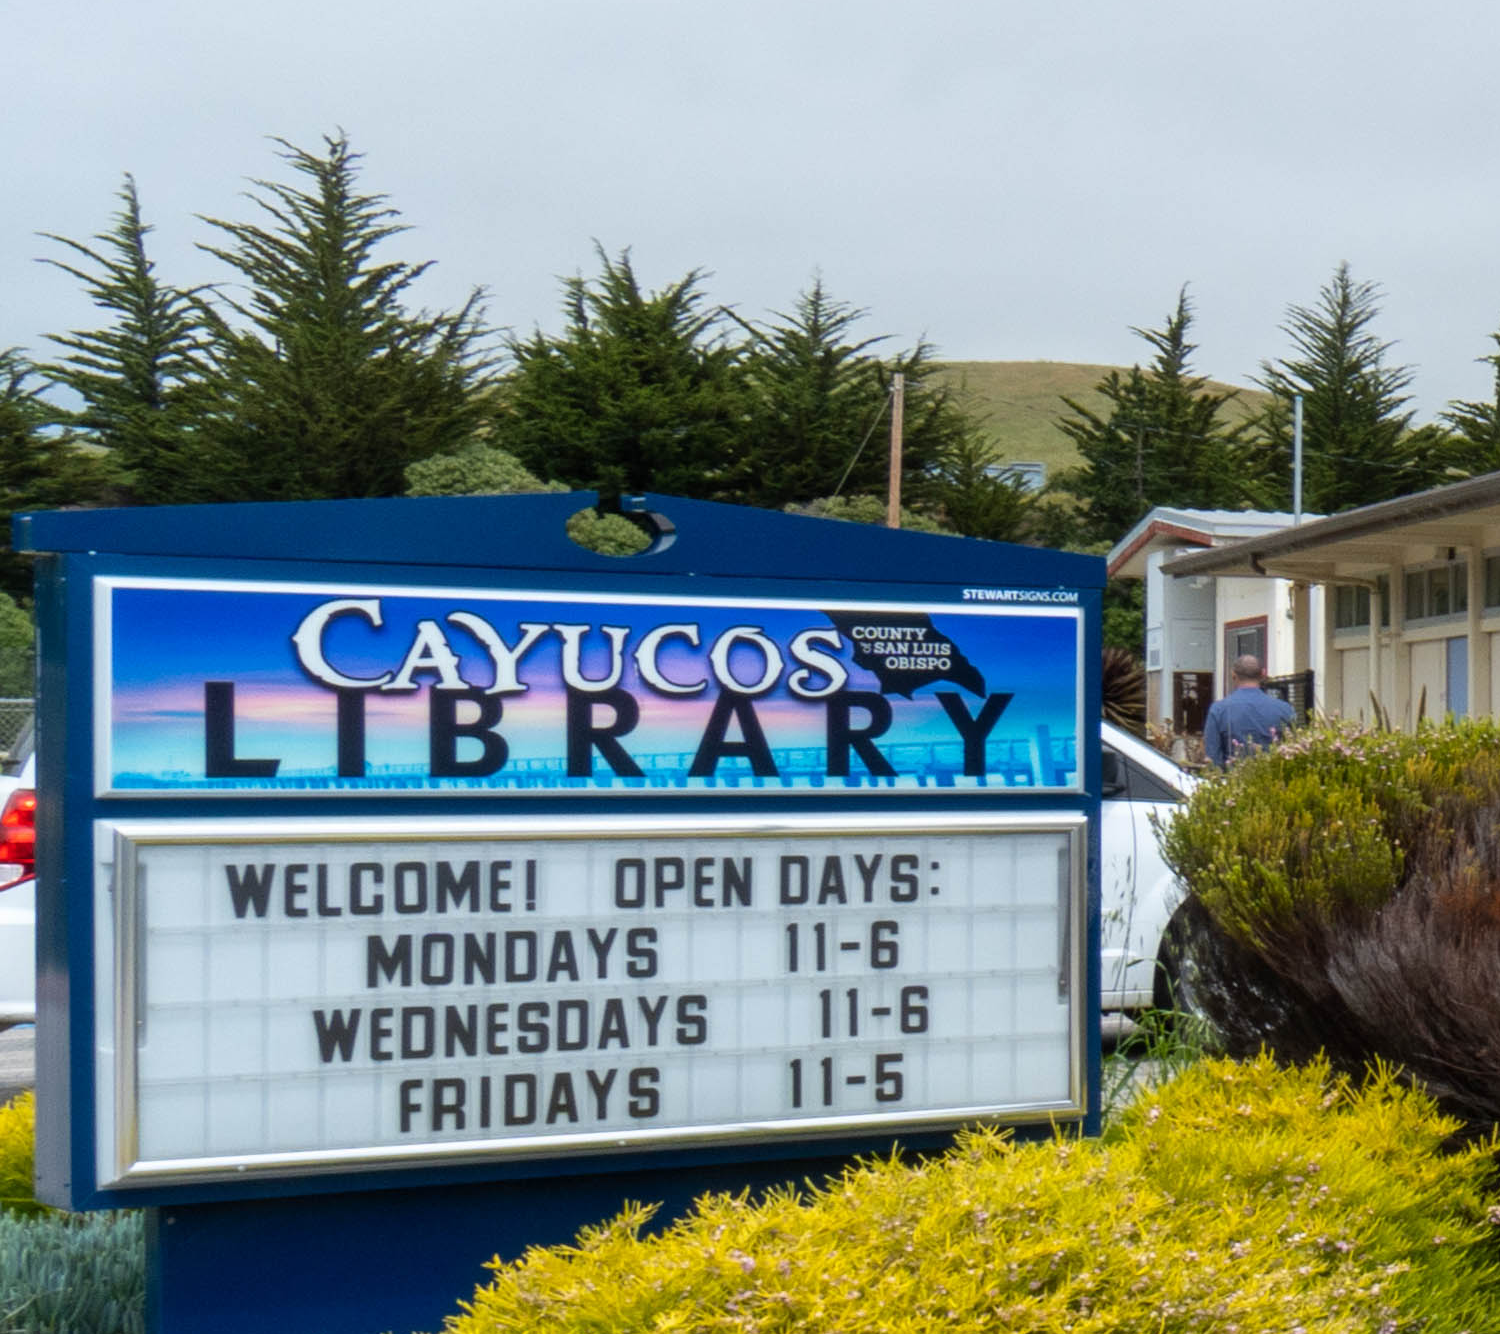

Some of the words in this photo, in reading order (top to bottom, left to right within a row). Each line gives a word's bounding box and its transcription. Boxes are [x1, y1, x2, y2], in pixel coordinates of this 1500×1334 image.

[962, 588, 1079, 603] STEWARTSIGNS.COM
[292, 598, 850, 698] CAYUCOS
[851, 625, 927, 641] COUNTY
[873, 641, 910, 655] SAN
[913, 642, 951, 656] LUIS
[885, 656, 951, 671] OBISPO
[204, 680, 1016, 779] LIBRARY
[225, 859, 537, 919] WELCOME!
[614, 857, 752, 909] OPEN
[779, 854, 941, 906] DAYS:
[366, 927, 658, 989] MONDAYS
[786, 920, 900, 973] 11-6
[313, 994, 708, 1064] WEDNESDAYS
[819, 985, 929, 1039] 11-6
[400, 1066, 661, 1134] FRIDAYS
[789, 1052, 904, 1109] 11-5
